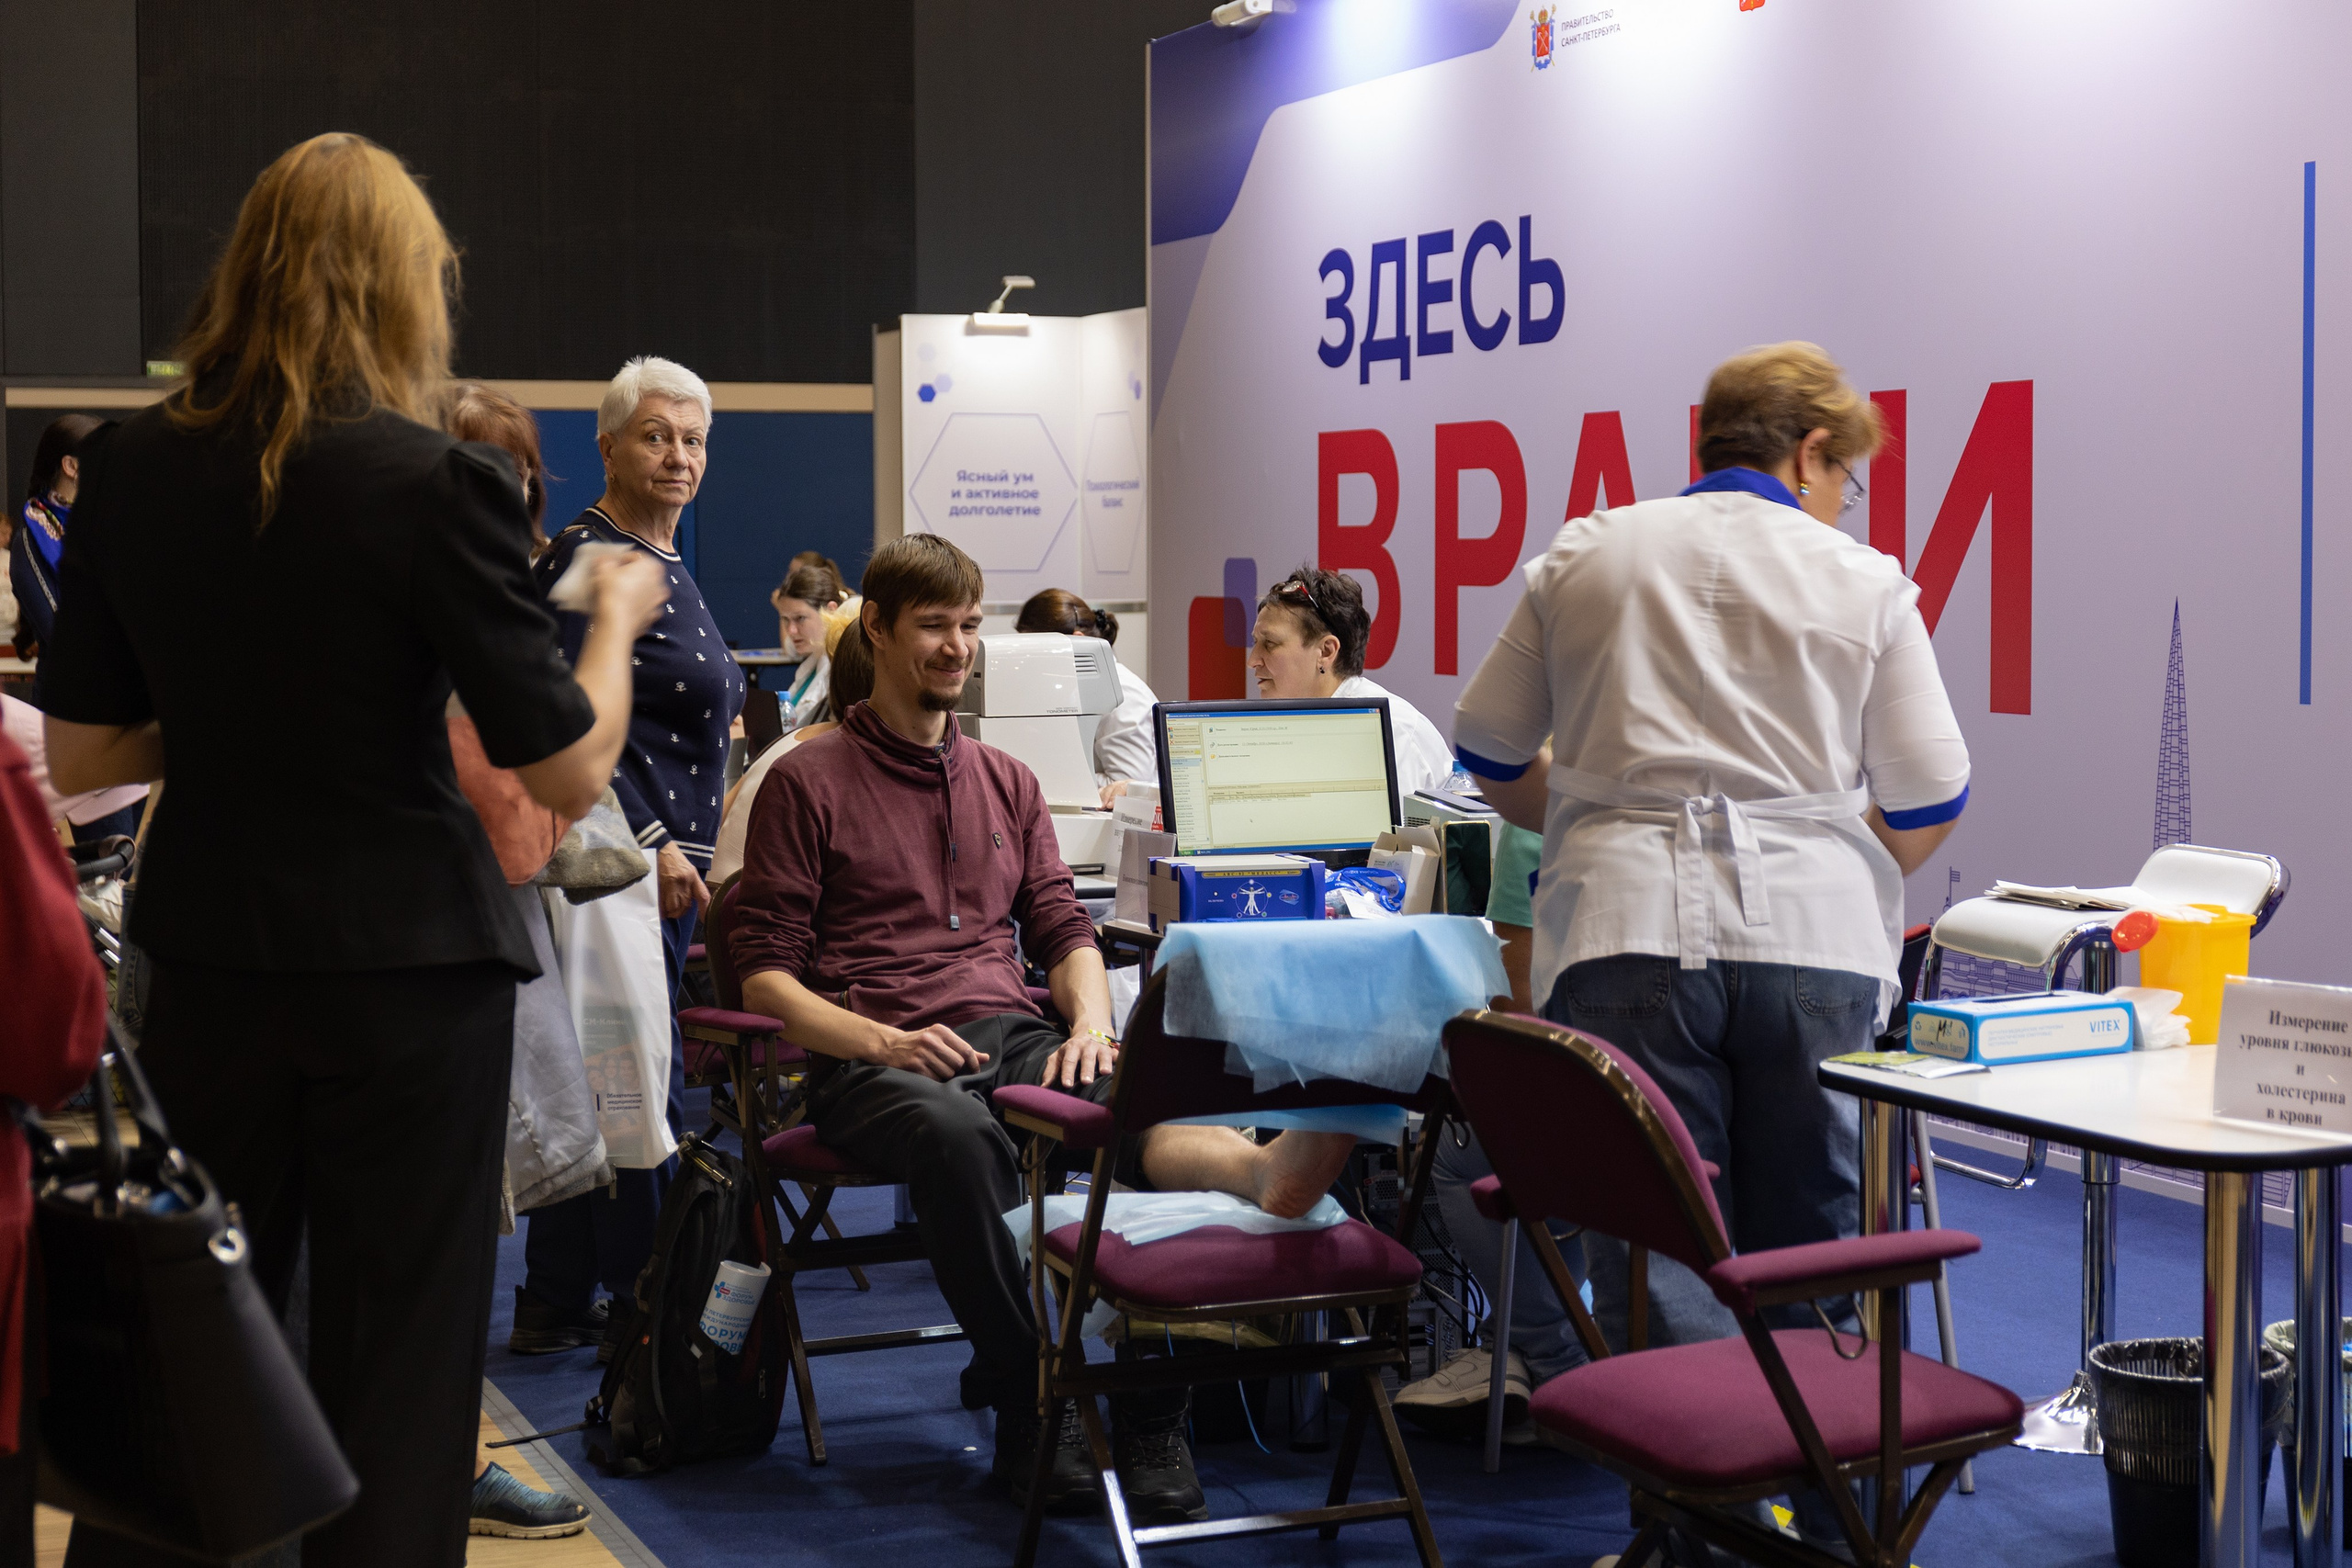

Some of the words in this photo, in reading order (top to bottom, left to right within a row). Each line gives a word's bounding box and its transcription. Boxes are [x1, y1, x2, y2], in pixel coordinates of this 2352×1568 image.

[1561, 8, 1614, 31] ПРАВИТЕЛЬСТВО
[1561, 23, 1621, 47] САНКТ-ПЕТЕРБУРГА
[1318, 214, 1566, 385] ЗДЕСЬ
[956, 468, 1009, 481] Ясный
[1013, 472, 1034, 485] ум
[951, 489, 961, 499] и
[966, 489, 1040, 499] активное
[949, 505, 1042, 517] долголетие
[1318, 379, 2034, 716] ВРИ
[2089, 1019, 2120, 1033] VITEX
[2268, 1010, 2348, 1033] Измерение
[2239, 1033, 2290, 1050] уровня
[2296, 1064, 2305, 1076] и
[2256, 1082, 2346, 1105] холестерина
[2267, 1108, 2275, 1119] в
[2279, 1109, 2323, 1125] крови
